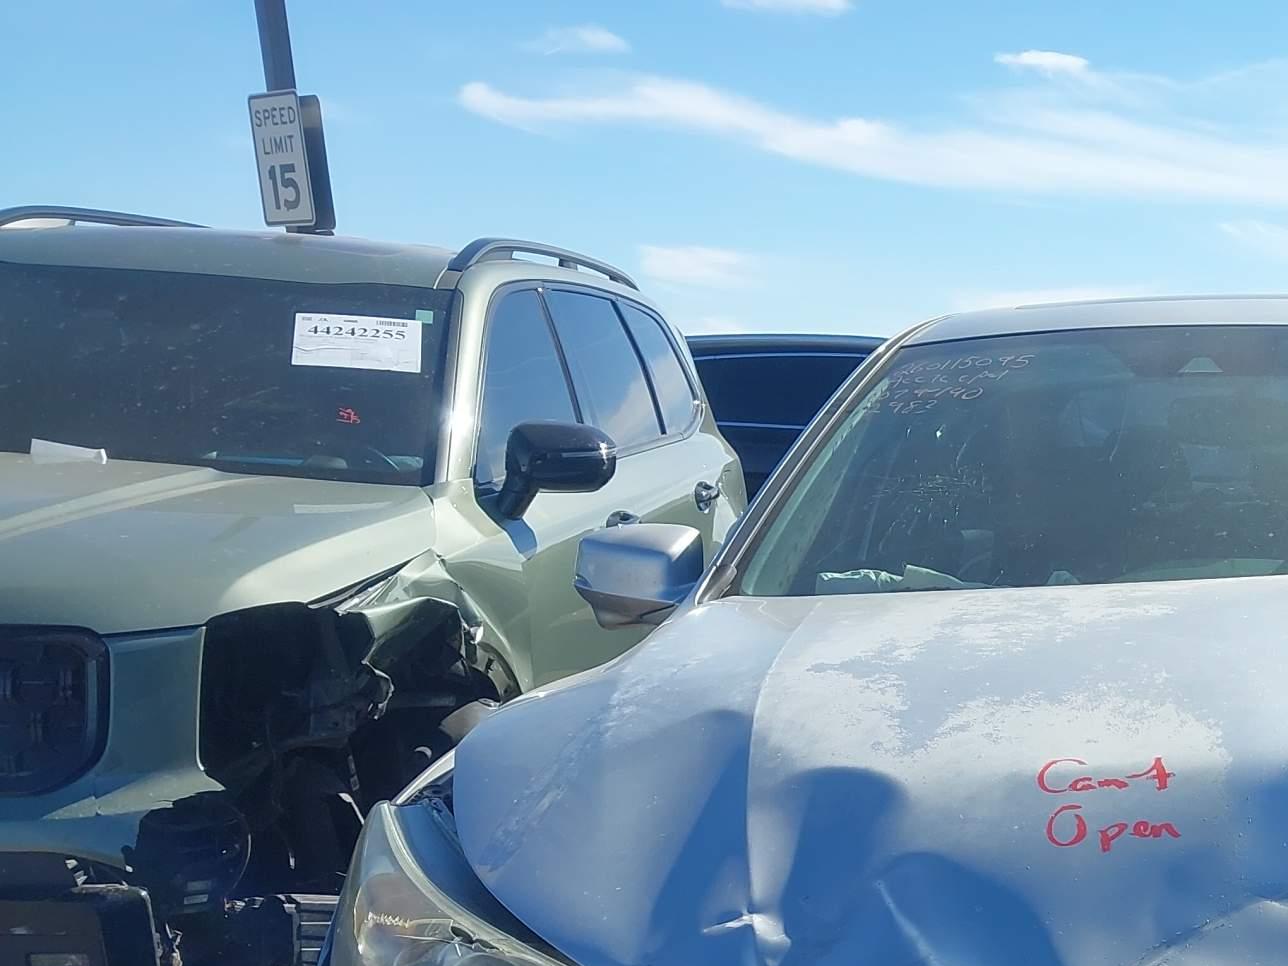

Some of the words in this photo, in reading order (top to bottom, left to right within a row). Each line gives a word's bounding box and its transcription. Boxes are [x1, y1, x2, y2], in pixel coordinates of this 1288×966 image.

[254, 106, 296, 127] SPEED
[262, 135, 294, 155] LIMIT
[268, 163, 301, 211] 15
[307, 325, 406, 340] 44242255
[1046, 804, 1182, 853] Open
